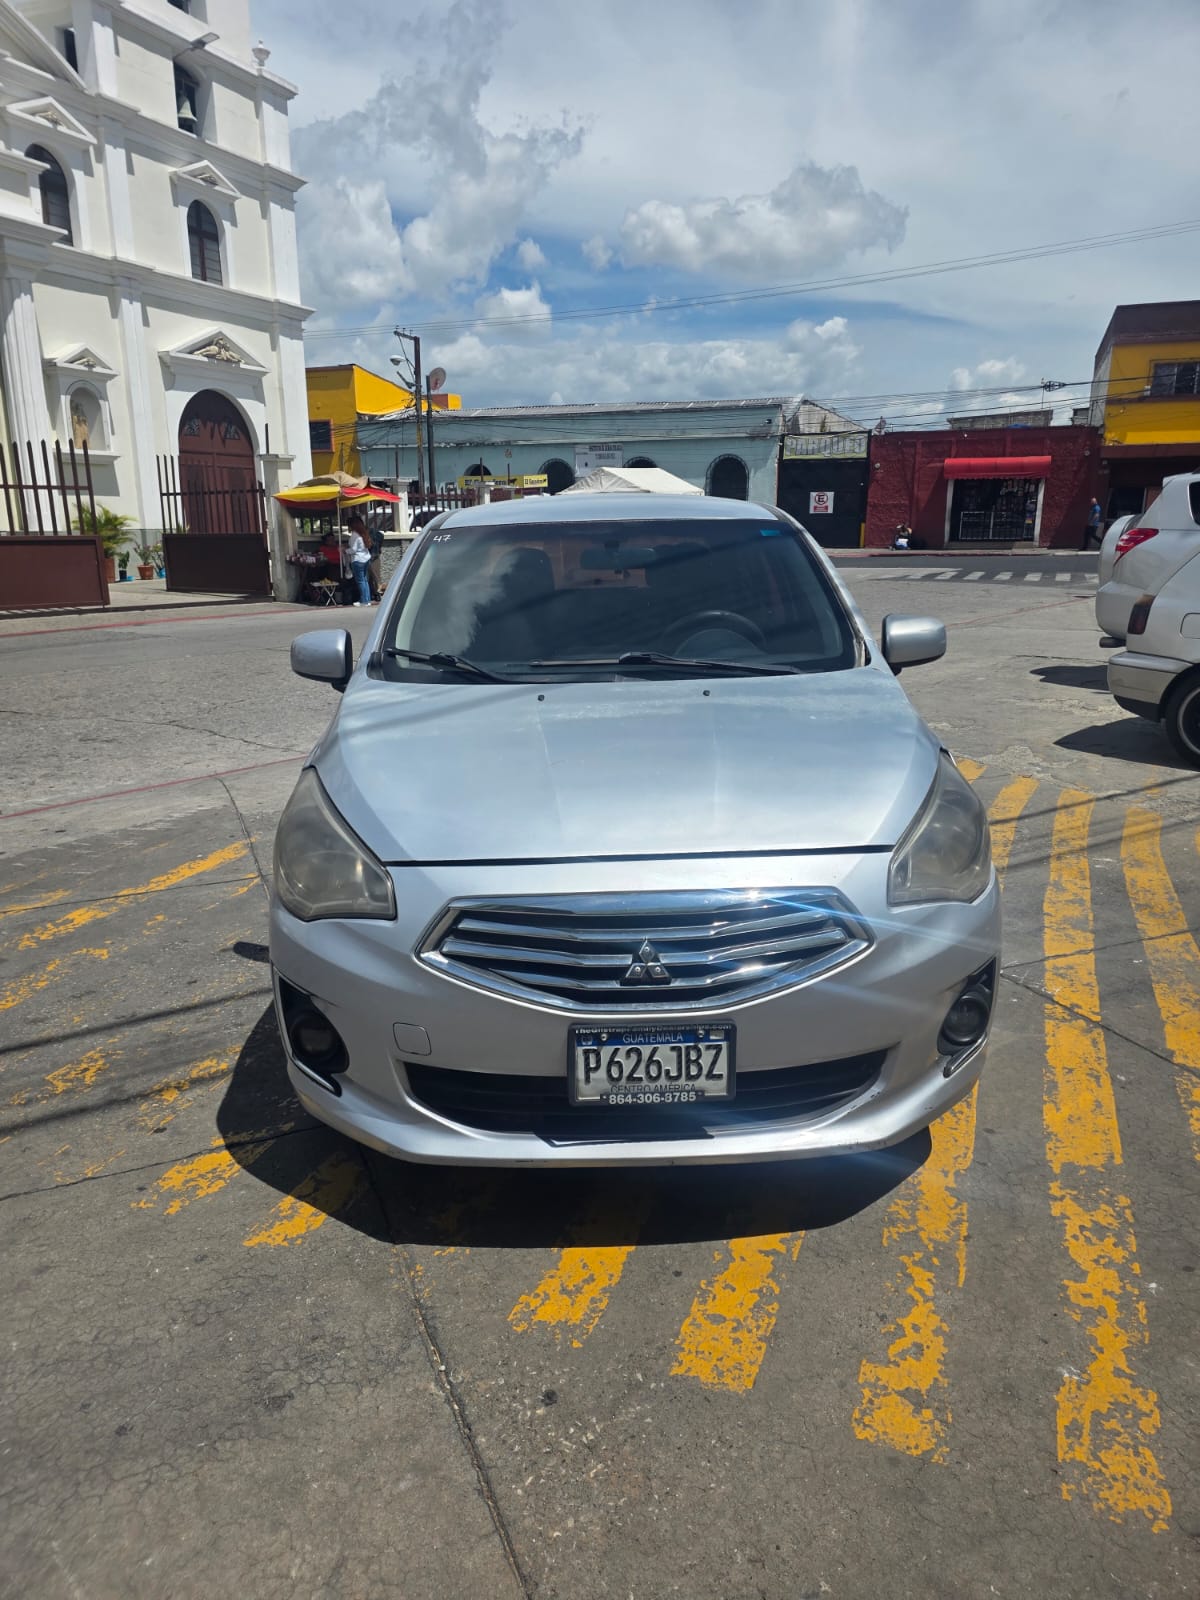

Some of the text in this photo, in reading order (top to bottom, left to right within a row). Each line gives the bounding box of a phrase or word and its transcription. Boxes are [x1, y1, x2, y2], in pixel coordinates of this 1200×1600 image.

[785, 436, 866, 457] PARQUEO
[433, 534, 452, 543] 47
[622, 1032, 684, 1044] GUATEMALA
[610, 1084, 652, 1093] CENTRO
[609, 1092, 697, 1105] 864-306-8785
